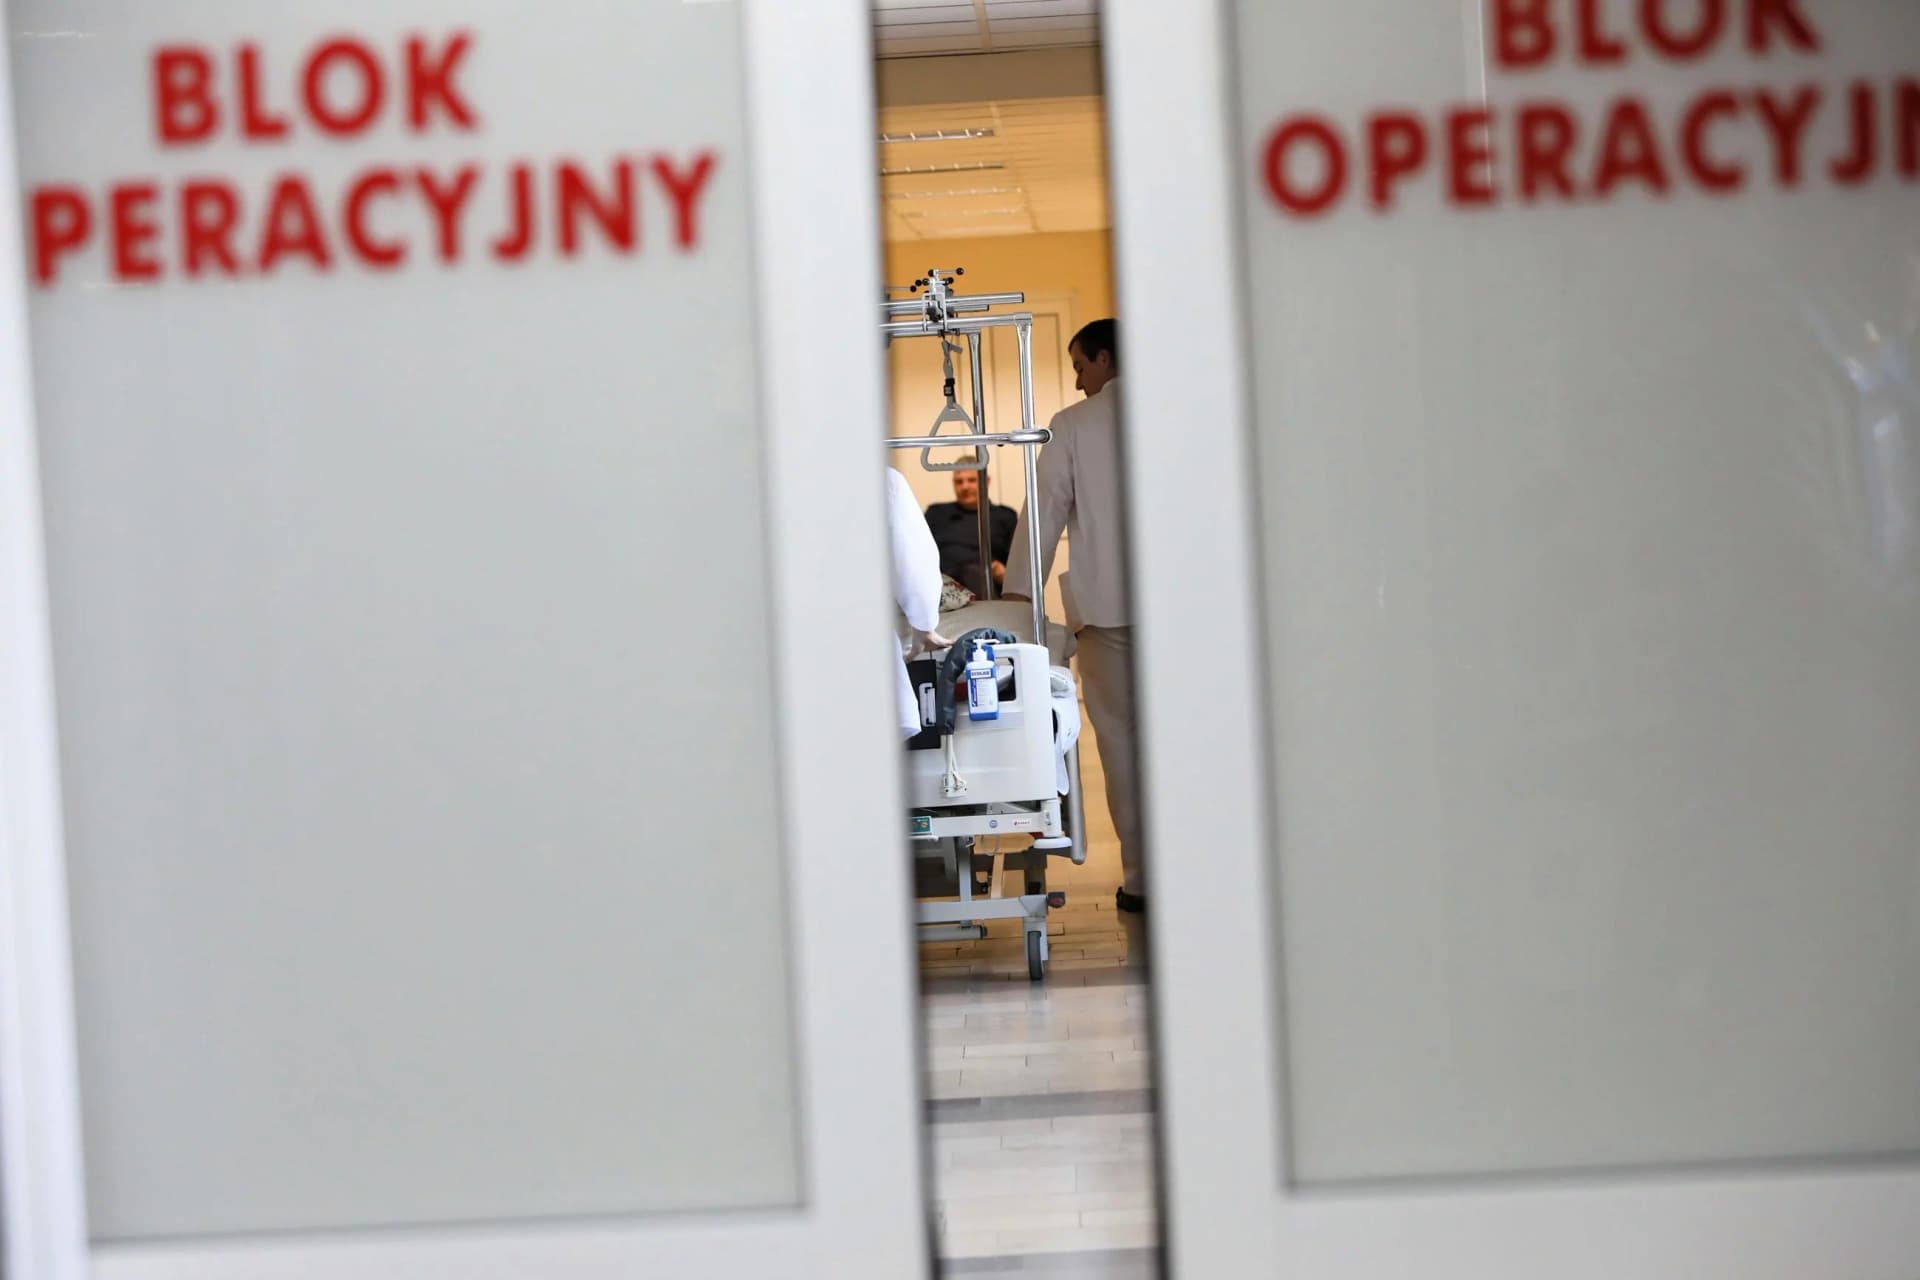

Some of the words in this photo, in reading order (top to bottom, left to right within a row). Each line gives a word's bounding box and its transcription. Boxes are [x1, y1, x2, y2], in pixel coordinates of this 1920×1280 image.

[150, 30, 478, 146] BLOK
[1492, 0, 1819, 69] BLOK
[27, 149, 718, 286] PERACYJNY
